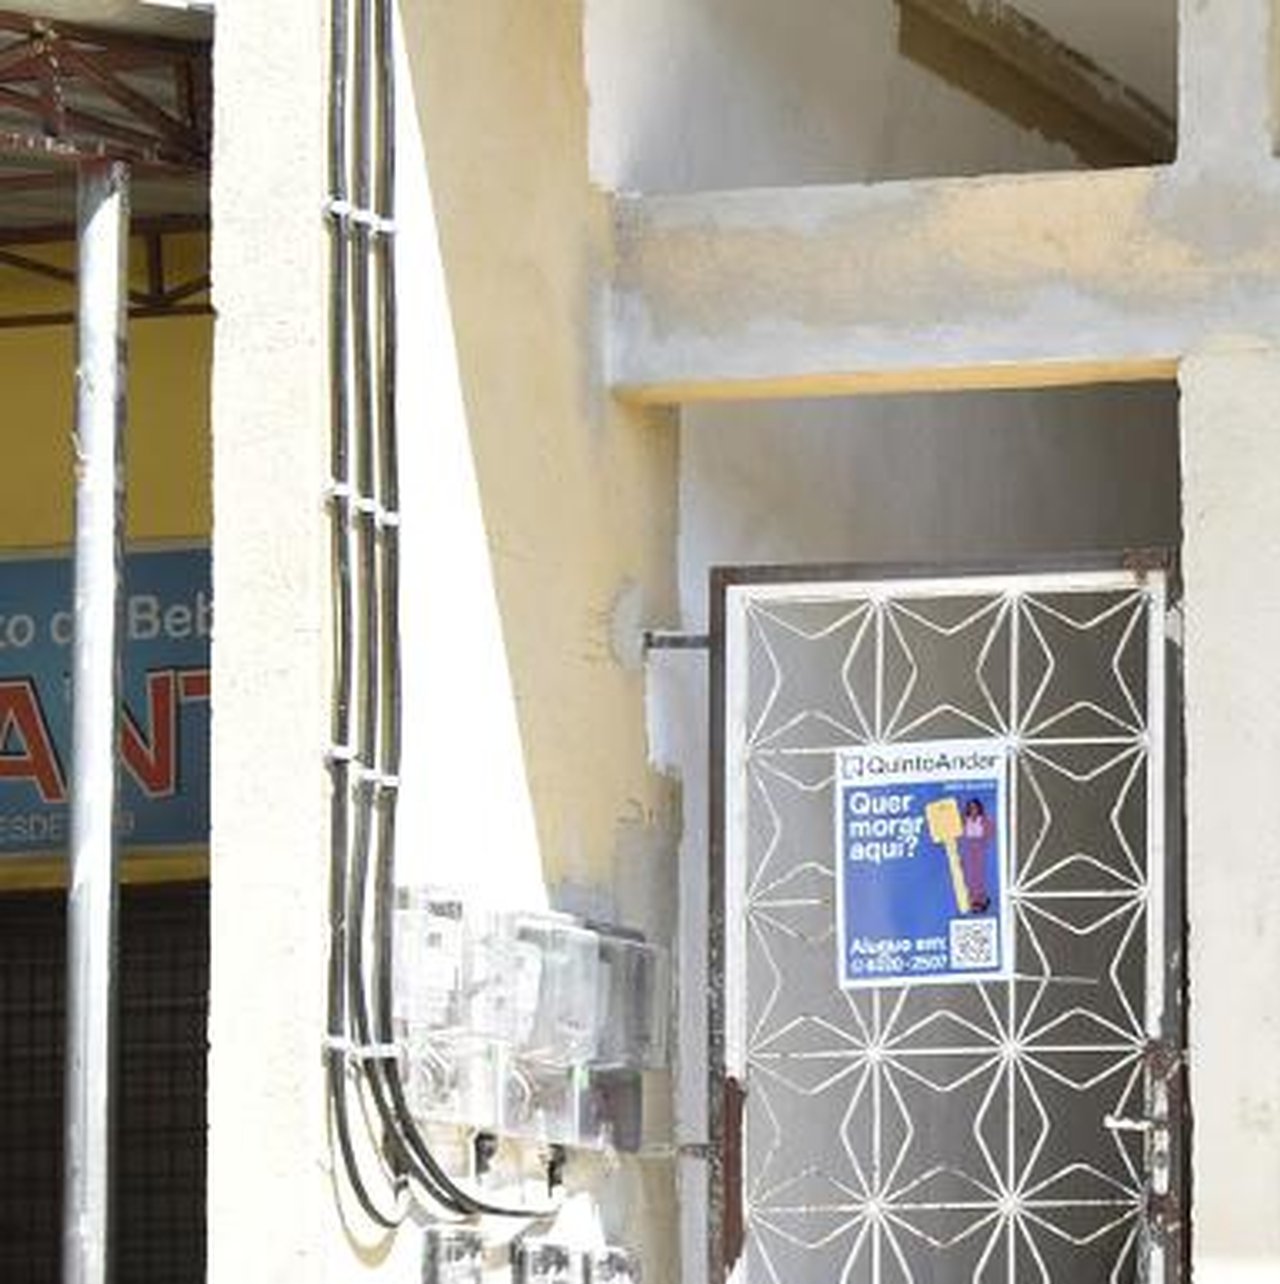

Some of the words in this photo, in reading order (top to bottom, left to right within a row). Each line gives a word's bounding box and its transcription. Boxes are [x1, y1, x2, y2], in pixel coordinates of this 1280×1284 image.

[867, 752, 999, 774] QuintoAndar
[851, 792, 914, 815] Quer
[851, 816, 924, 837] morar
[851, 837, 918, 863] aqui?
